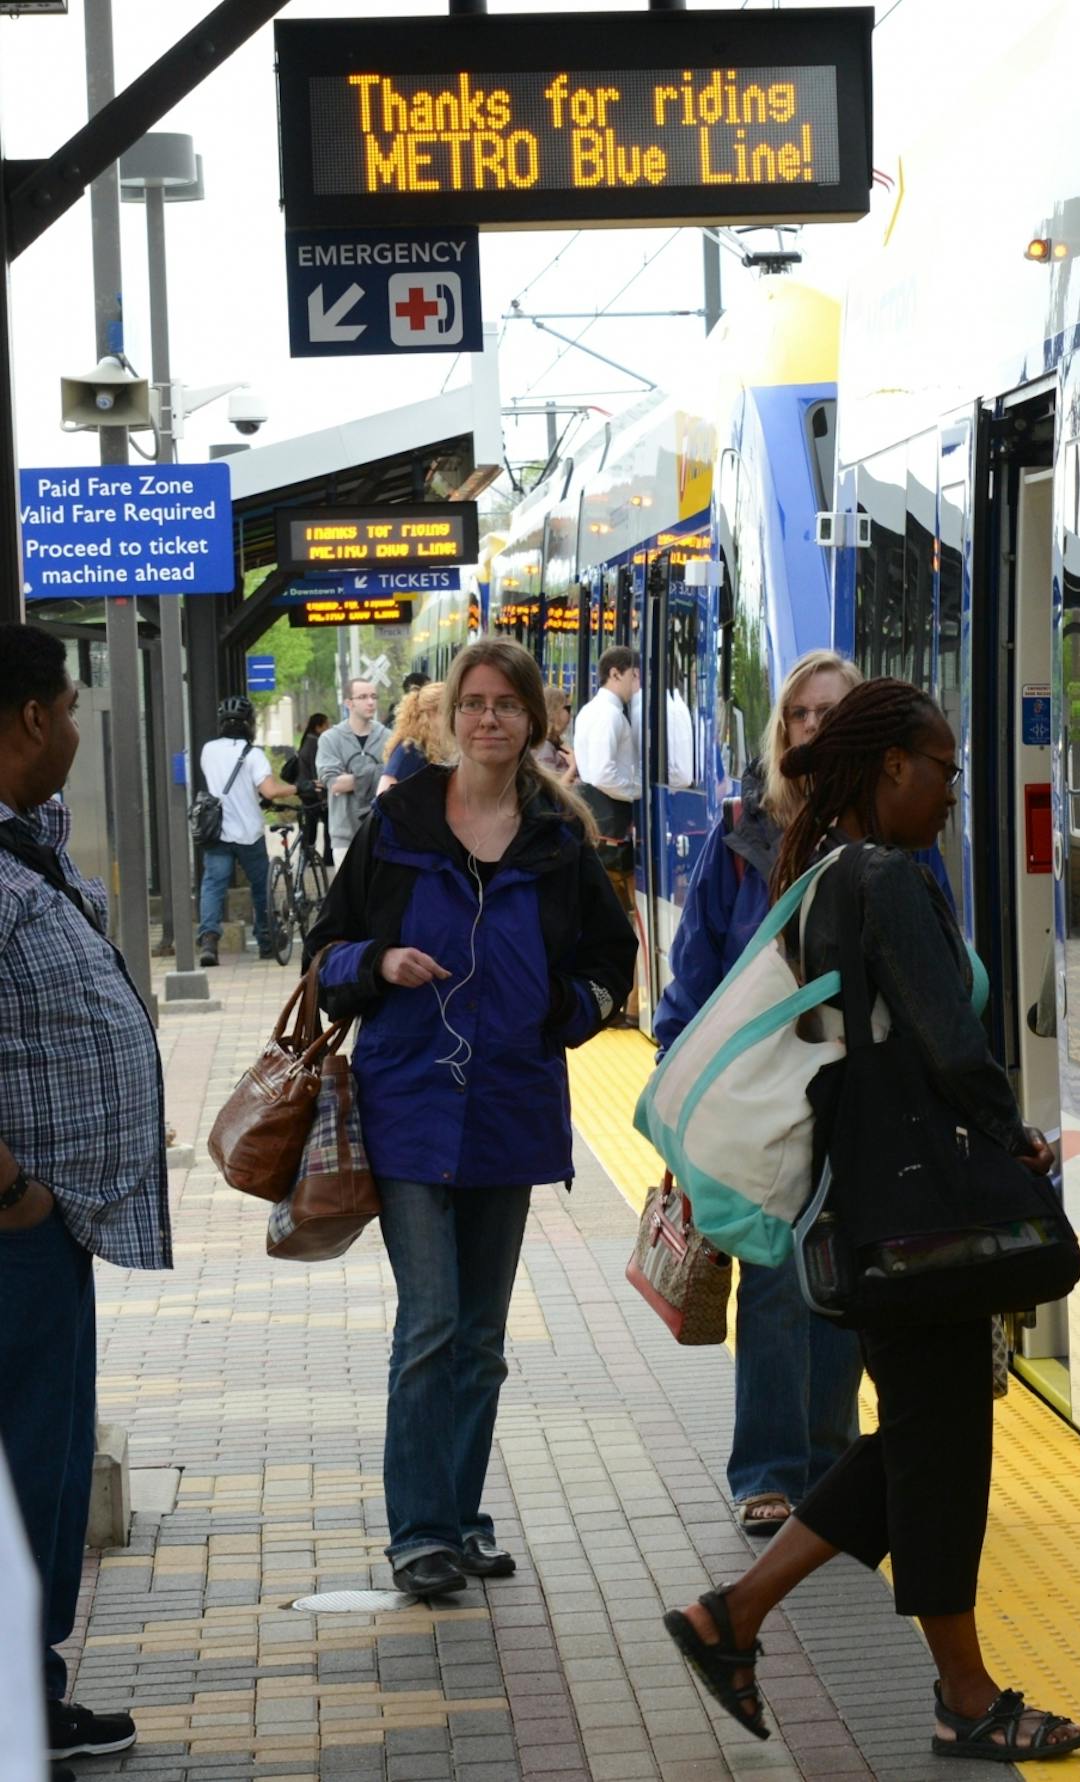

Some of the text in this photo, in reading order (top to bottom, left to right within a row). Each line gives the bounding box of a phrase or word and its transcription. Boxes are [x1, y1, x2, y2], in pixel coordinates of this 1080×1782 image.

[349, 70, 796, 134] Thanks for riding
[366, 123, 815, 192] METRO Blue Line!
[298, 241, 467, 268] EMERGENCY
[38, 475, 194, 498] Paid Fare Zone
[20, 501, 216, 526] Valid Fare Required
[26, 535, 209, 558] Proceed to ticket
[42, 561, 195, 584] machine ahead
[379, 572, 450, 588] TICKETS
[289, 587, 337, 597] Downtown
